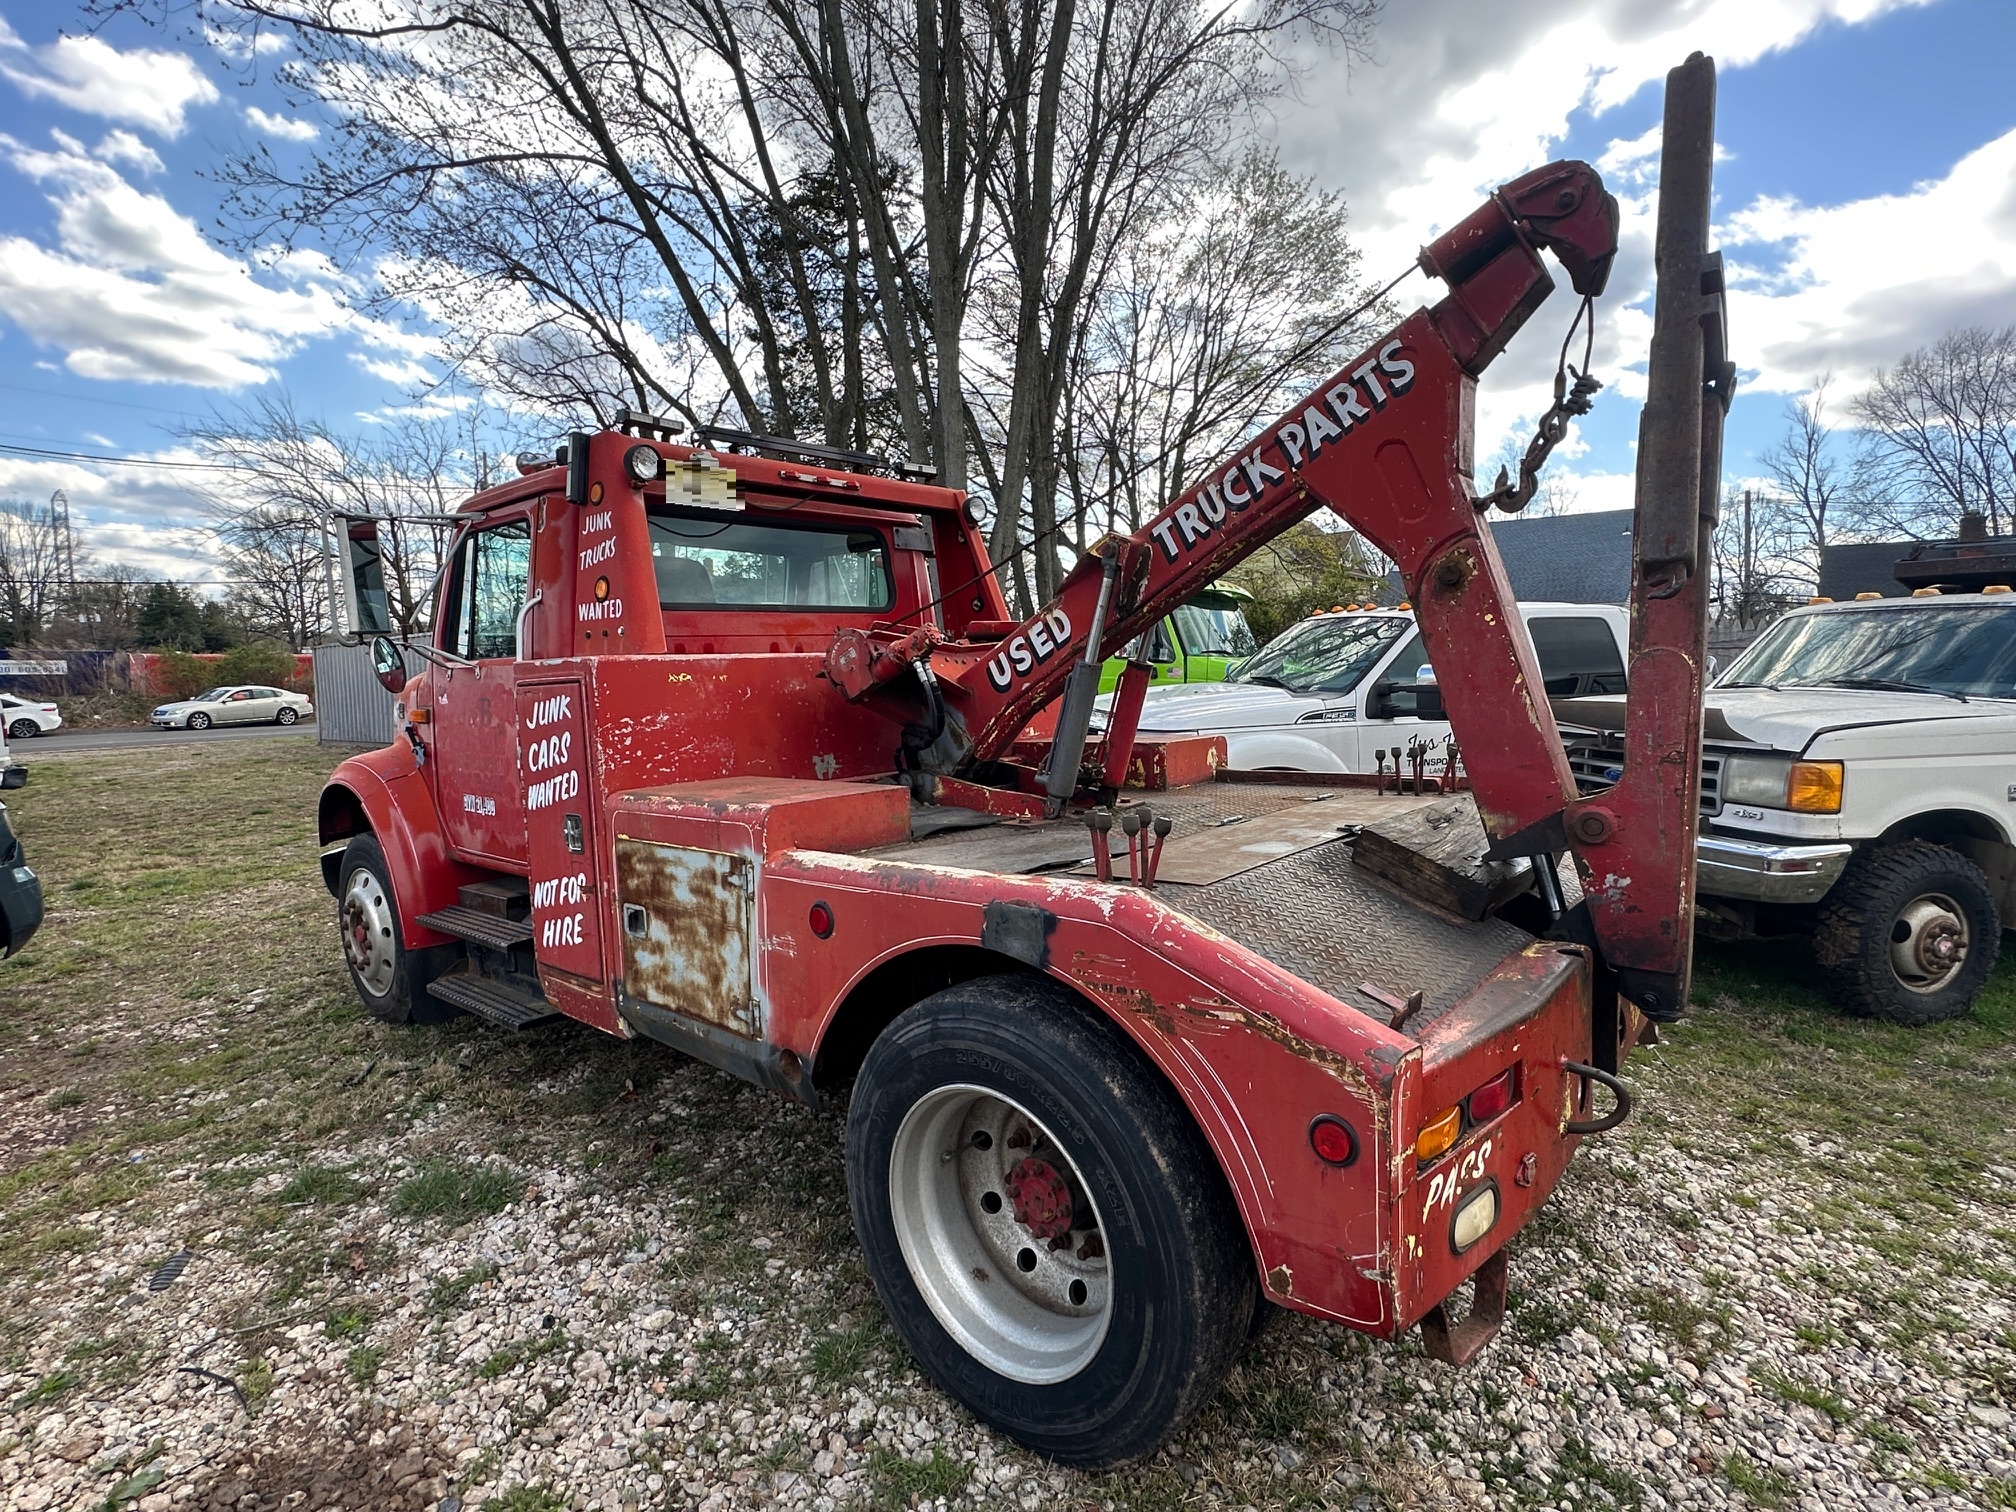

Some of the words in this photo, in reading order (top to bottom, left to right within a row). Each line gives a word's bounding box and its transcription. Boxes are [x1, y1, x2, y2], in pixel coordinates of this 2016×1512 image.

[581, 511, 613, 536] JUNK
[988, 609, 1072, 690] USED
[1151, 445, 1286, 562] TRUCK
[1277, 338, 1416, 466] PARTS
[579, 535, 617, 572] TRUCKS
[577, 598, 624, 622] WANTED
[525, 694, 572, 730] JUNK
[527, 731, 571, 772] CARS
[527, 769, 579, 811] WANTED
[533, 880, 559, 910] NOT
[559, 872, 587, 906] FOR
[542, 912, 584, 948] HIRE
